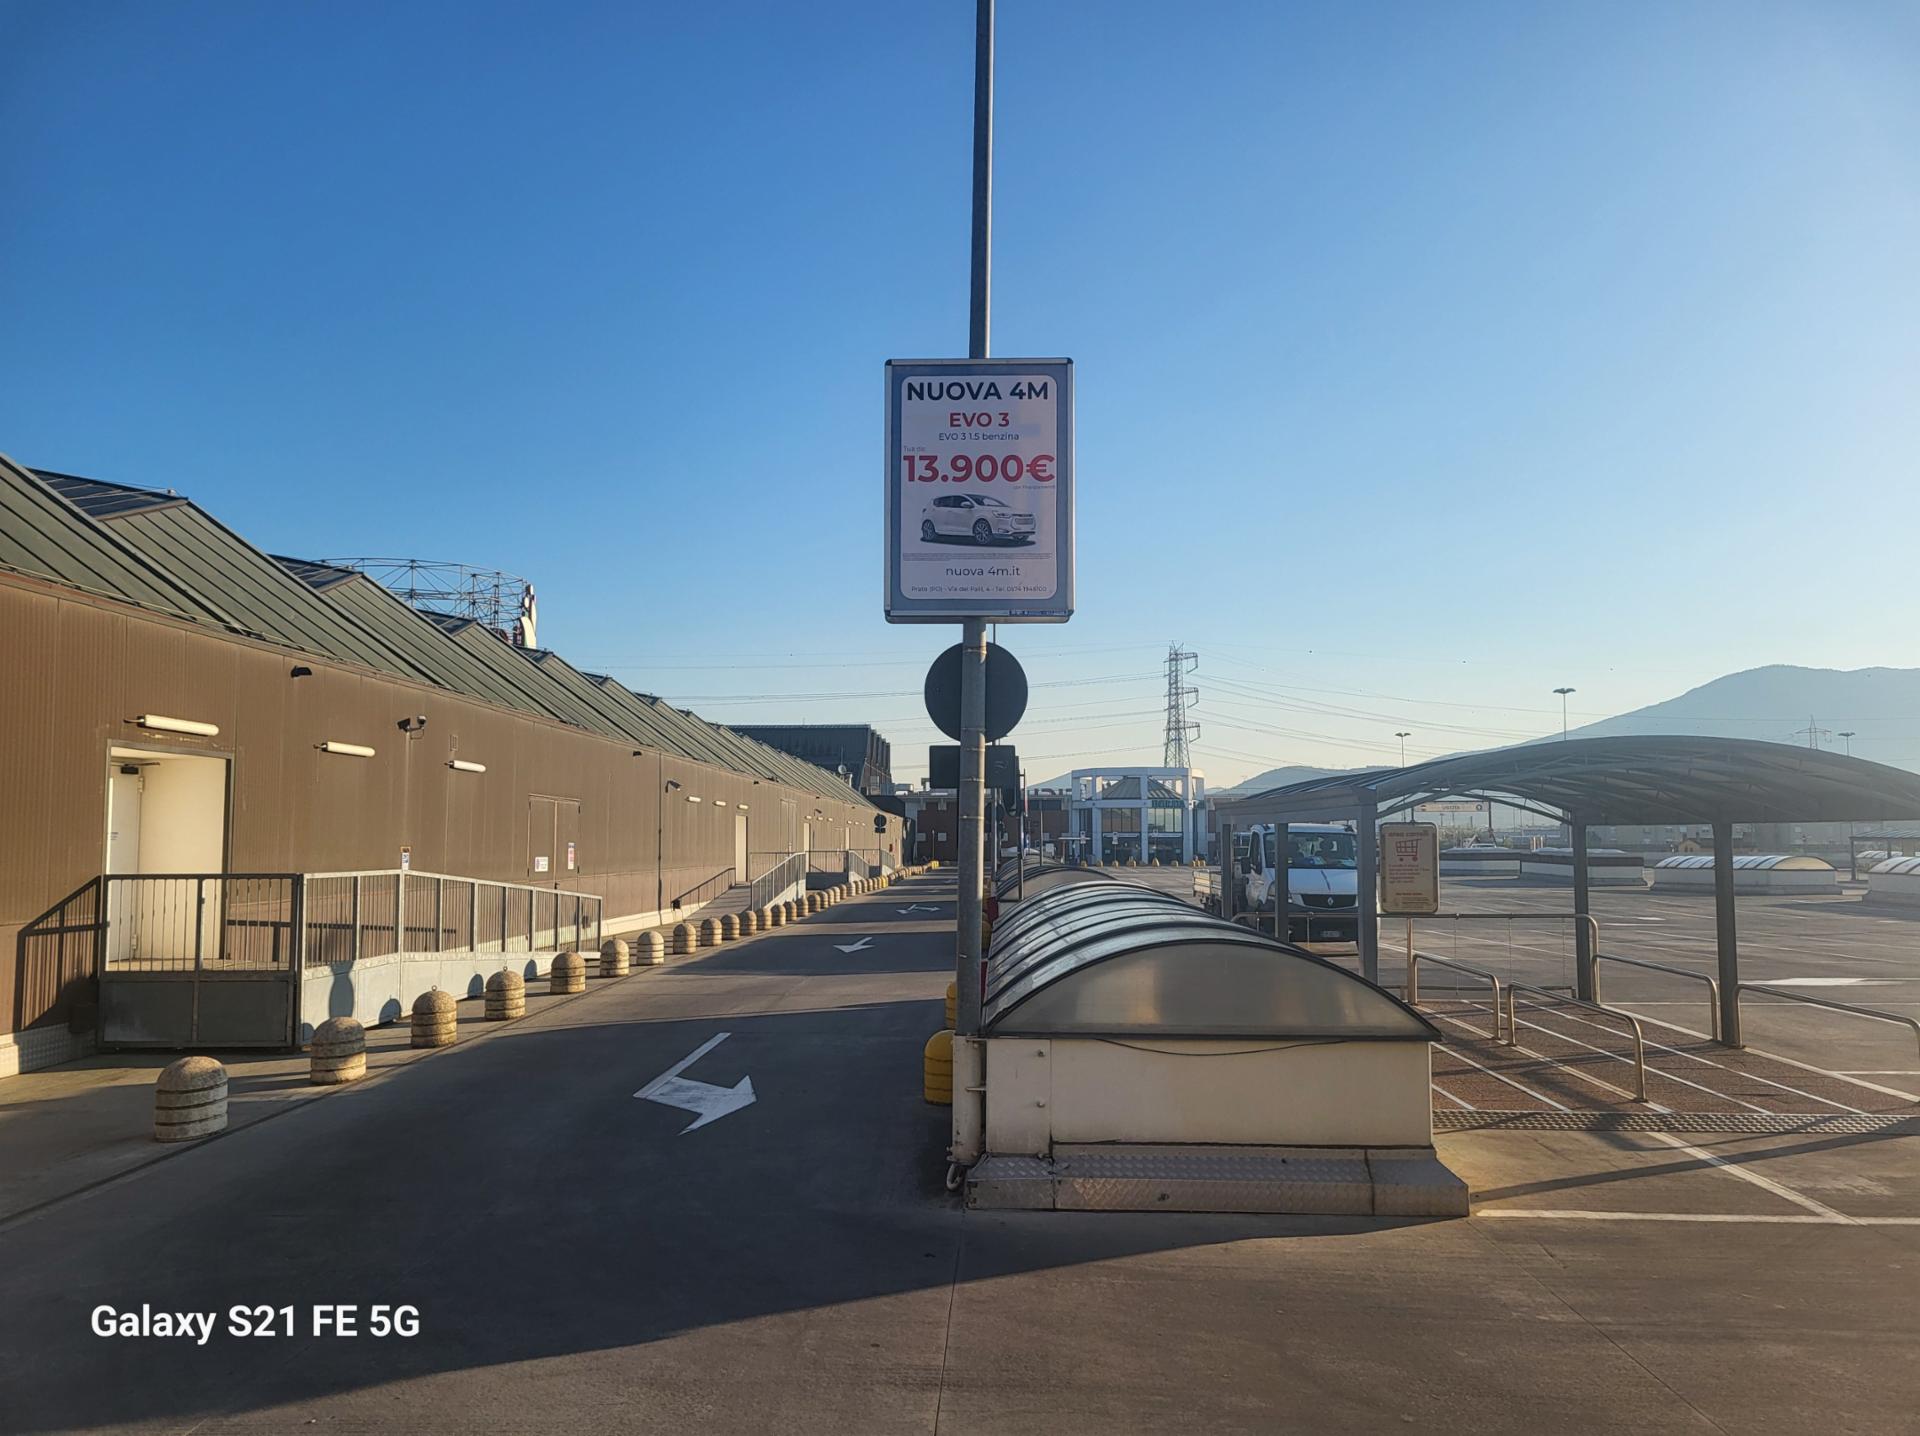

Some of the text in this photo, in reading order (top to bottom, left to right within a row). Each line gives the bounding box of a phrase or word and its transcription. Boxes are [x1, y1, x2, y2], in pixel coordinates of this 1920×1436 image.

[907, 381, 1049, 401] NUOVA 4M
[949, 412, 1010, 427] EVO 3
[938, 431, 1020, 441] EVO 3 1.5 benzina
[902, 454, 1056, 483] 13.900€
[945, 565, 1021, 576] nuova 4m.it
